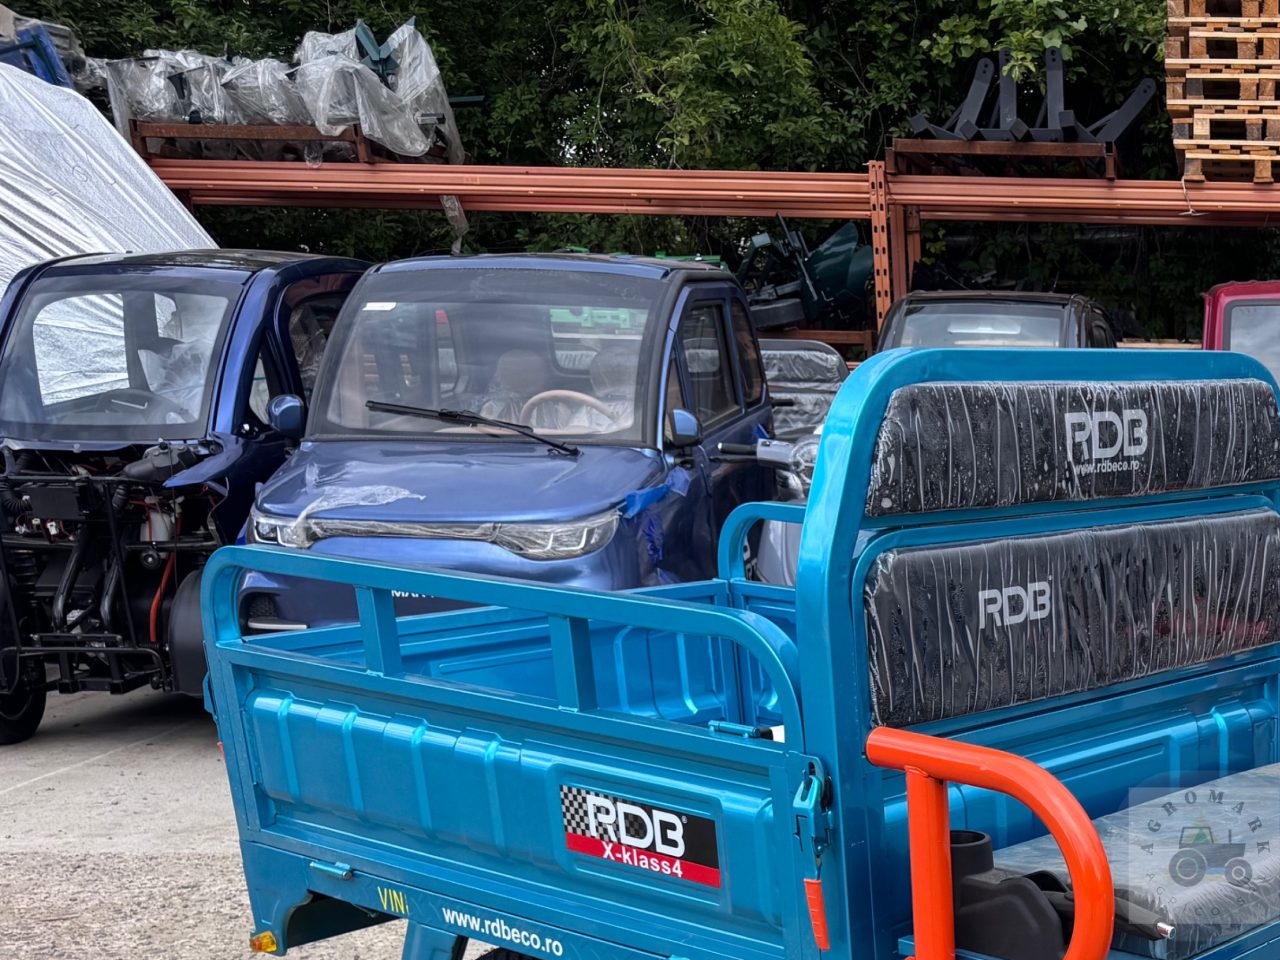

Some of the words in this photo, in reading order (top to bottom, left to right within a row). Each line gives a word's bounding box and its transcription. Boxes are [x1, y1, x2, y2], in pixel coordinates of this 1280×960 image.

[1065, 409, 1148, 461] RDB
[979, 581, 1051, 629] RDB
[586, 795, 685, 857] RDB
[601, 841, 683, 877] X-klass4
[442, 907, 563, 957] www.rdbeco.ro
